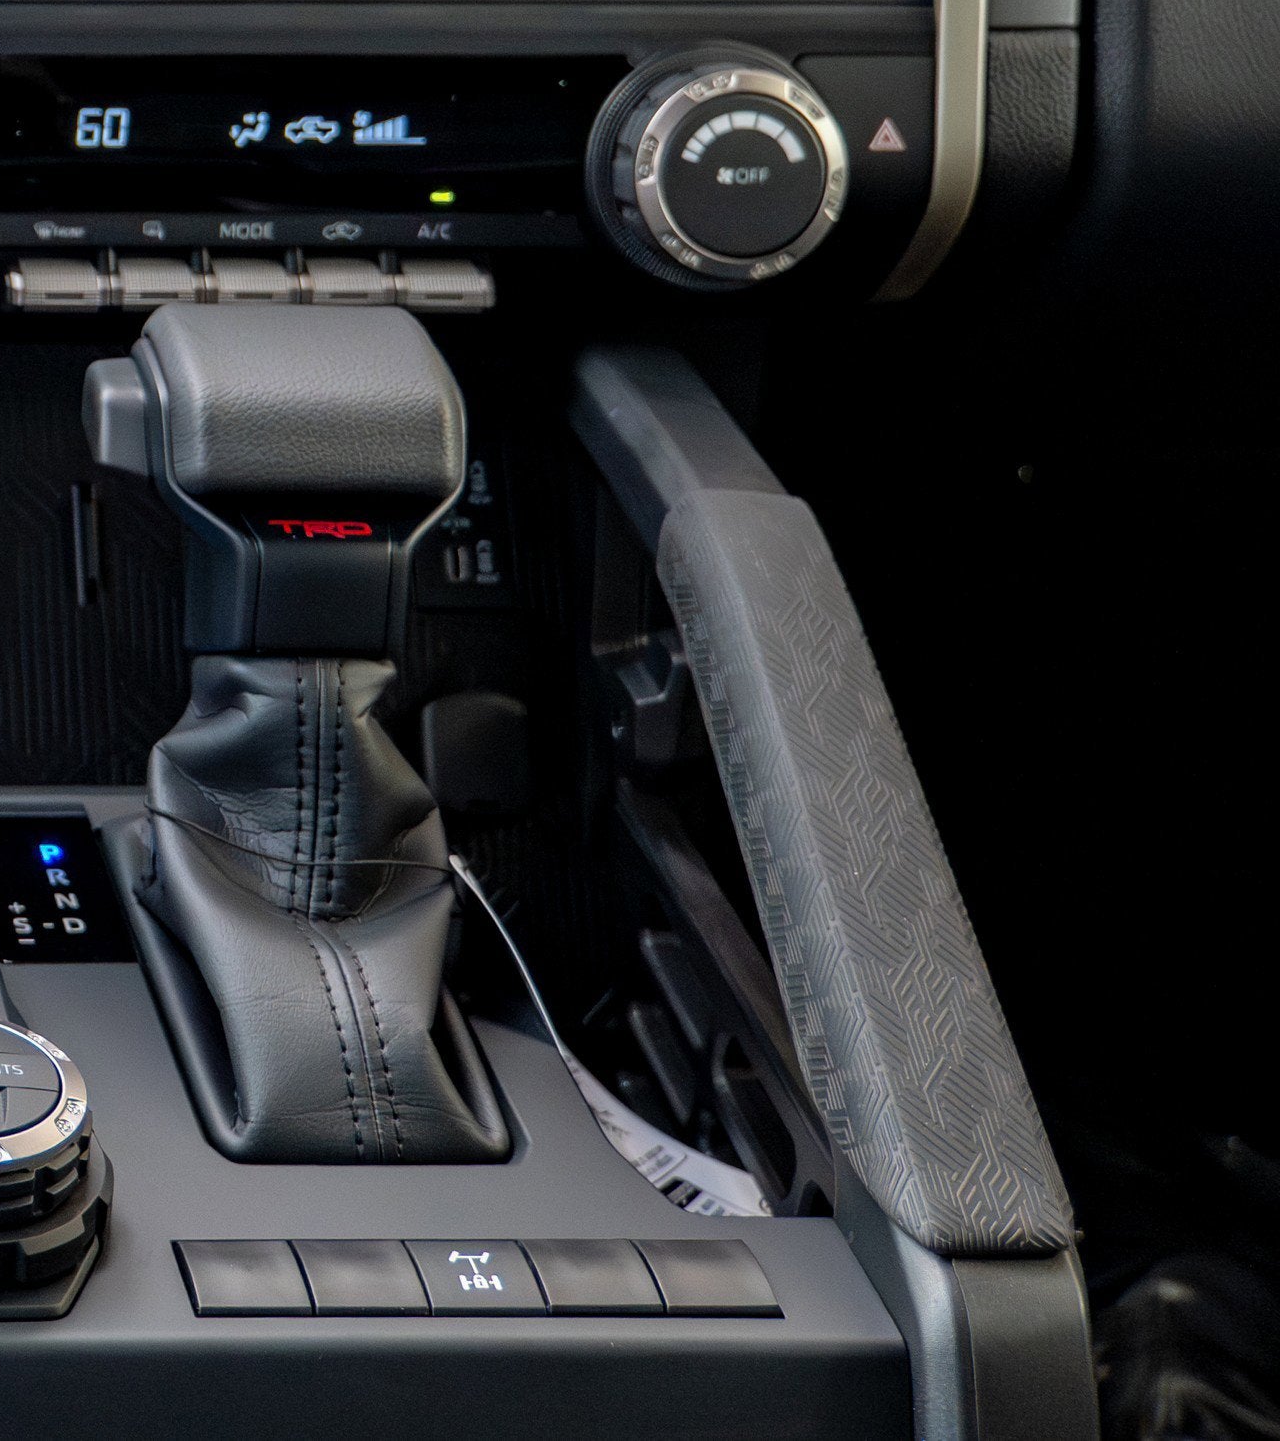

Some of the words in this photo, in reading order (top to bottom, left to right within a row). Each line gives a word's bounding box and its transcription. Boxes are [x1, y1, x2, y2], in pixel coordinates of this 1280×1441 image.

[74, 106, 131, 149] 60
[734, 166, 771, 185] OFF
[219, 221, 276, 241] MODE
[416, 222, 452, 242] A/C
[267, 519, 373, 539] TRD
[39, 843, 64, 864] P
[46, 868, 70, 886] R
[54, 892, 80, 910] N
[12, 917, 33, 935] S
[62, 917, 87, 935] D
